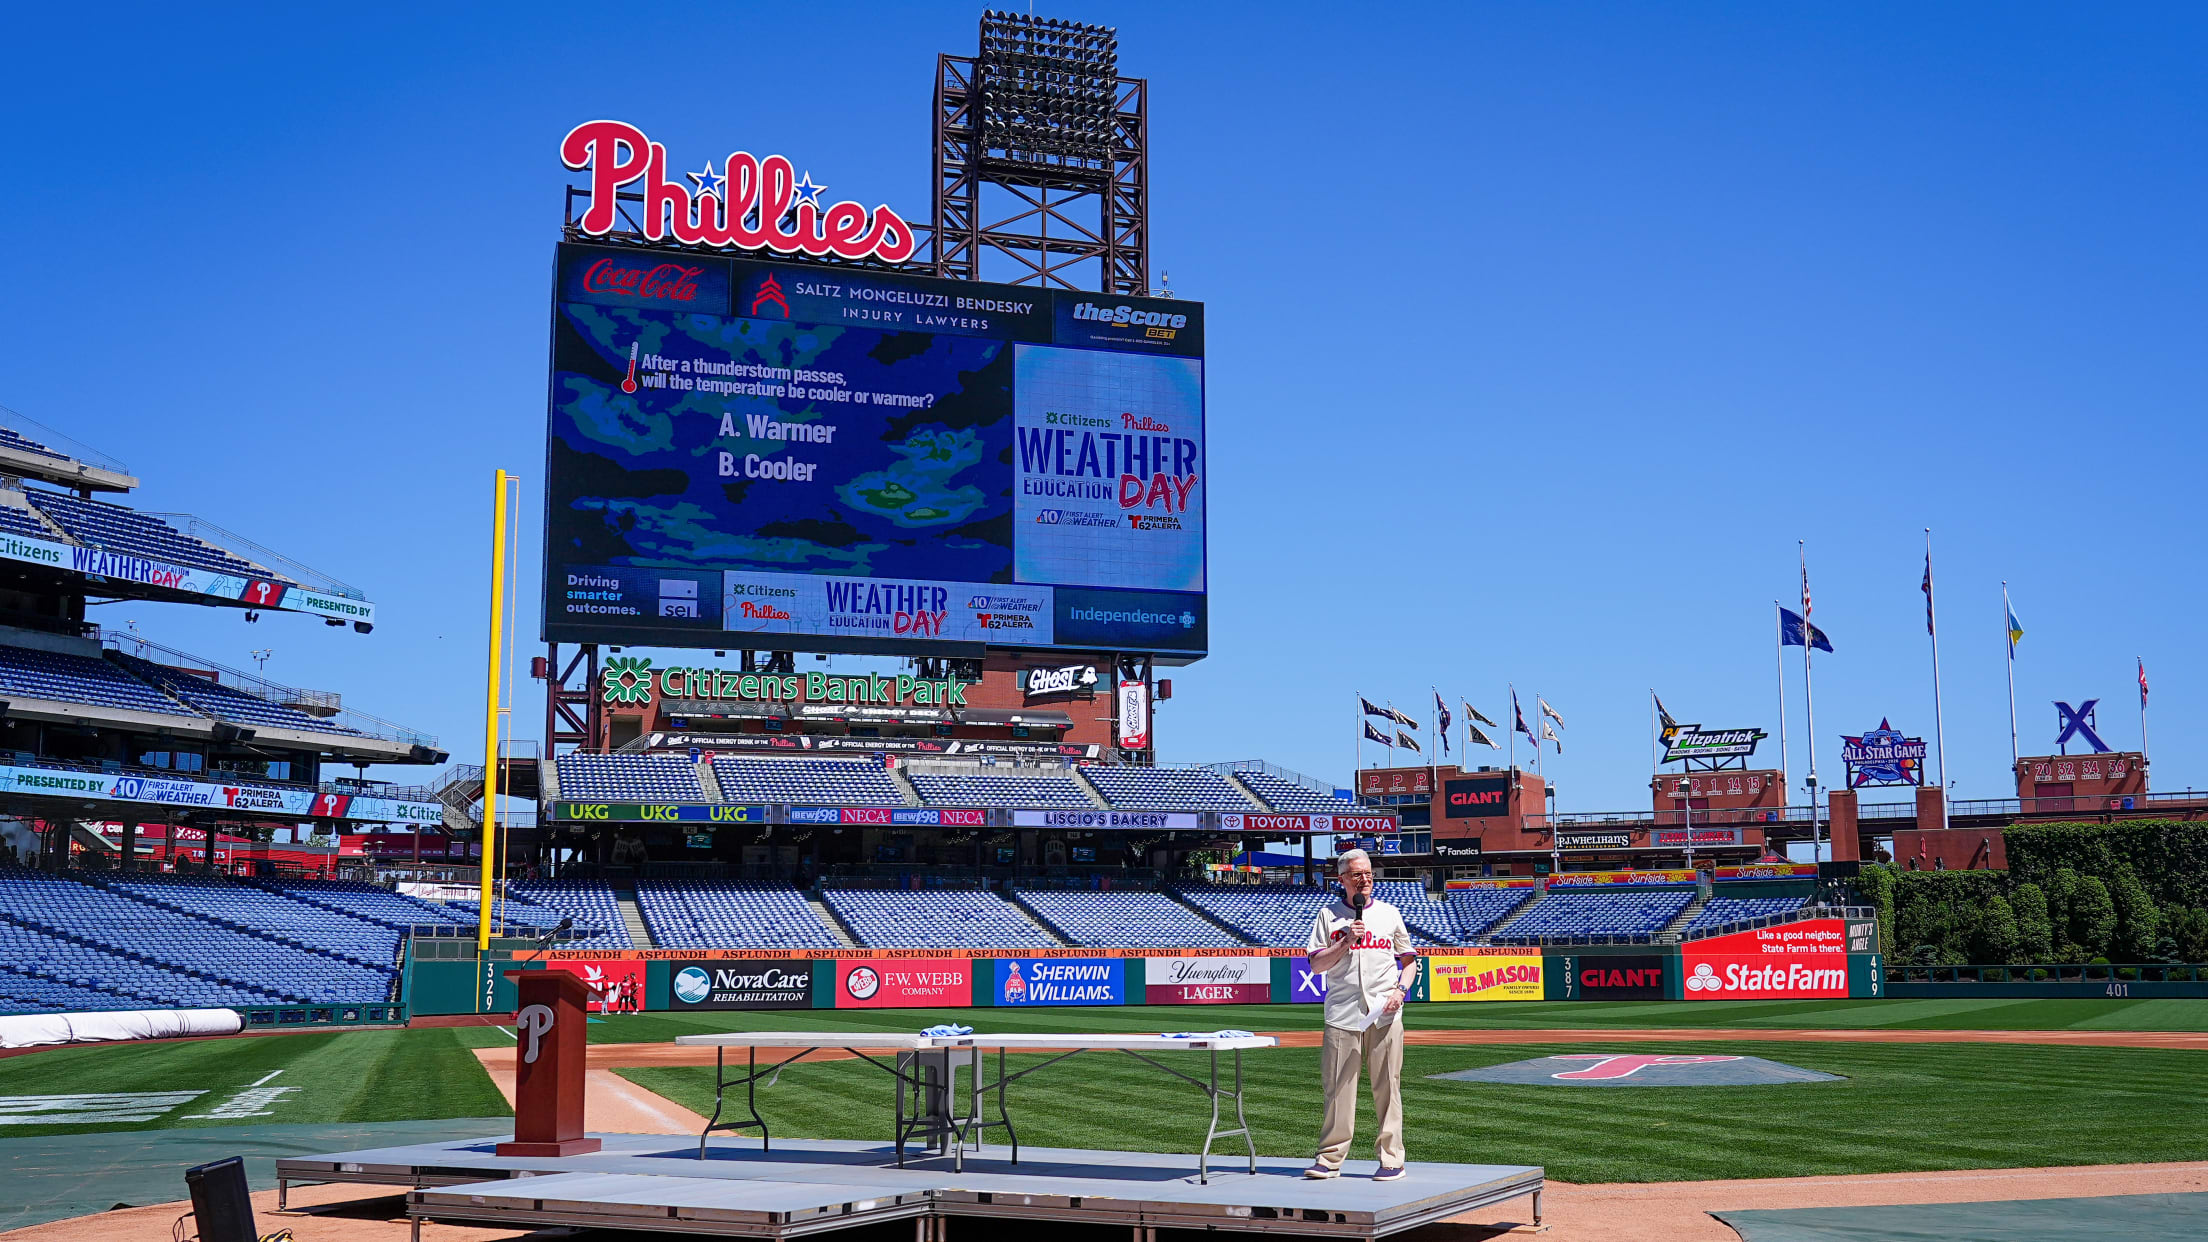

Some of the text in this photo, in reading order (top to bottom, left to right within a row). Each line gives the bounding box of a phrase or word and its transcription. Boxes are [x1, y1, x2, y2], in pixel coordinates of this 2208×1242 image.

[560, 119, 915, 263] Phillies
[796, 282, 1033, 315] SALTZ MONGELUZZI BENDESKY
[843, 307, 989, 330] INJURY LAWYERS
[1073, 302, 1187, 328] theScore
[1148, 329, 1173, 338] BET
[641, 353, 847, 386] After a thunderstorm passes,
[641, 373, 934, 408] will the temperature be cooler or warmer?
[718, 412, 836, 444] A. Warmer
[1060, 414, 1111, 428] Citizens
[1121, 412, 1170, 432] Phillies
[1018, 426, 1198, 484] WEATHER
[718, 451, 817, 482] B. Cooler
[1023, 478, 1113, 500] EDUCATION
[1119, 472, 1199, 514] DAY
[1073, 518, 1116, 528] WEATHER
[1138, 521, 1151, 530] 62
[1143, 516, 1179, 524] PRIMERA
[72, 546, 152, 583] WEATHER
[152, 563, 190, 577] EDUCATION
[151, 569, 185, 589] DAY
[567, 574, 620, 590] Driving
[566, 590, 623, 601] smarter
[747, 584, 796, 597] Citizens
[826, 581, 948, 617] WEATHER
[306, 596, 371, 617] PRESENTED BY
[566, 604, 641, 616] outcomes.
[741, 601, 791, 620] Phillies
[1000, 602, 1038, 612] WEATHER
[829, 615, 890, 629] EDUCATION
[993, 613, 1031, 622] PRIMERA
[1071, 606, 1176, 625] Independence
[893, 610, 948, 637] DAY
[988, 621, 1034, 630] 62 ALERTA
[660, 666, 968, 706] Citizens Bank Park
[1029, 665, 1085, 695] GHOST
[2051, 698, 2114, 752] X
[1663, 728, 1680, 738] PJ
[1668, 726, 1755, 748] Fitzpatrick
[770, 737, 796, 747] Phillies
[917, 741, 941, 751] Phillies
[1059, 745, 1082, 755] Phillies
[1895, 744, 1925, 758] GAME
[2035, 762, 2051, 776] 20
[2058, 762, 2075, 775] 32
[2082, 761, 2099, 774] 34
[2108, 760, 2125, 773] 36
[17, 774, 105, 792] PRESENTED BY
[1370, 775, 1380, 788] P
[1393, 774, 1403, 787] P
[1416, 772, 1426, 786] P
[1711, 778, 1717, 791] 1
[1728, 777, 1741, 790] 14
[1747, 776, 1760, 790] 15
[148, 781, 194, 792] FIRST ALERT
[156, 791, 209, 805] WEATHER
[240, 788, 281, 800] PRIMERA
[1450, 790, 1503, 806] GIANT
[234, 798, 284, 808] 62 ALERTA
[570, 804, 609, 820] UKG
[640, 805, 679, 821] UKG
[709, 806, 748, 822] UKG
[843, 808, 887, 823] NECA
[943, 811, 985, 825] NECA
[1044, 811, 1169, 828] LISCIO'S BAKERY
[1248, 814, 1306, 830] TOYOTA
[1337, 816, 1393, 831] TOYOTA
[1447, 846, 1479, 856] Fanatics
[1556, 874, 1593, 886] Surfside
[1628, 872, 1666, 885] Surfside
[1736, 867, 1774, 879] Surfside
[1757, 931, 1774, 940] Like
[1783, 931, 1803, 942] good
[1805, 930, 1843, 942] neighbor,
[1849, 922, 1874, 938] MONTY'S
[1762, 944, 1785, 953] State
[1786, 944, 1808, 953] Farm
[1810, 944, 1817, 953] is
[1851, 937, 1869, 951] ANGLE
[548, 951, 622, 960] ASPLUNDH
[636, 951, 708, 960] ASPLUNDH
[721, 950, 791, 959] ASPLUNDH
[805, 950, 873, 958] ASPLUNDH
[886, 950, 953, 958] ASPLUNDH
[966, 949, 1031, 957] ASPLUNDH
[1043, 949, 1108, 957] ASPLUNDH
[1119, 949, 1182, 957] ASPLUNDH
[1193, 949, 1254, 957] ASPLUNDH
[1415, 948, 1465, 956] SPLUNDH
[1477, 947, 1534, 956] ASPLUNDH
[1031, 962, 1110, 981] SHERWIN
[1170, 960, 1249, 984] Yuengling
[1435, 965, 1468, 975] WHO BUT
[712, 967, 808, 990] NovaCare
[853, 976, 874, 992] WEBB
[884, 972, 963, 986] F.W. WEBB
[1581, 969, 1662, 988] GIANT
[713, 991, 805, 1002] REHABILITATION
[902, 987, 945, 996] COMPANY
[1183, 986, 1234, 1000] LAGER
[2105, 983, 2129, 997] 401
[516, 1004, 554, 1064] P
